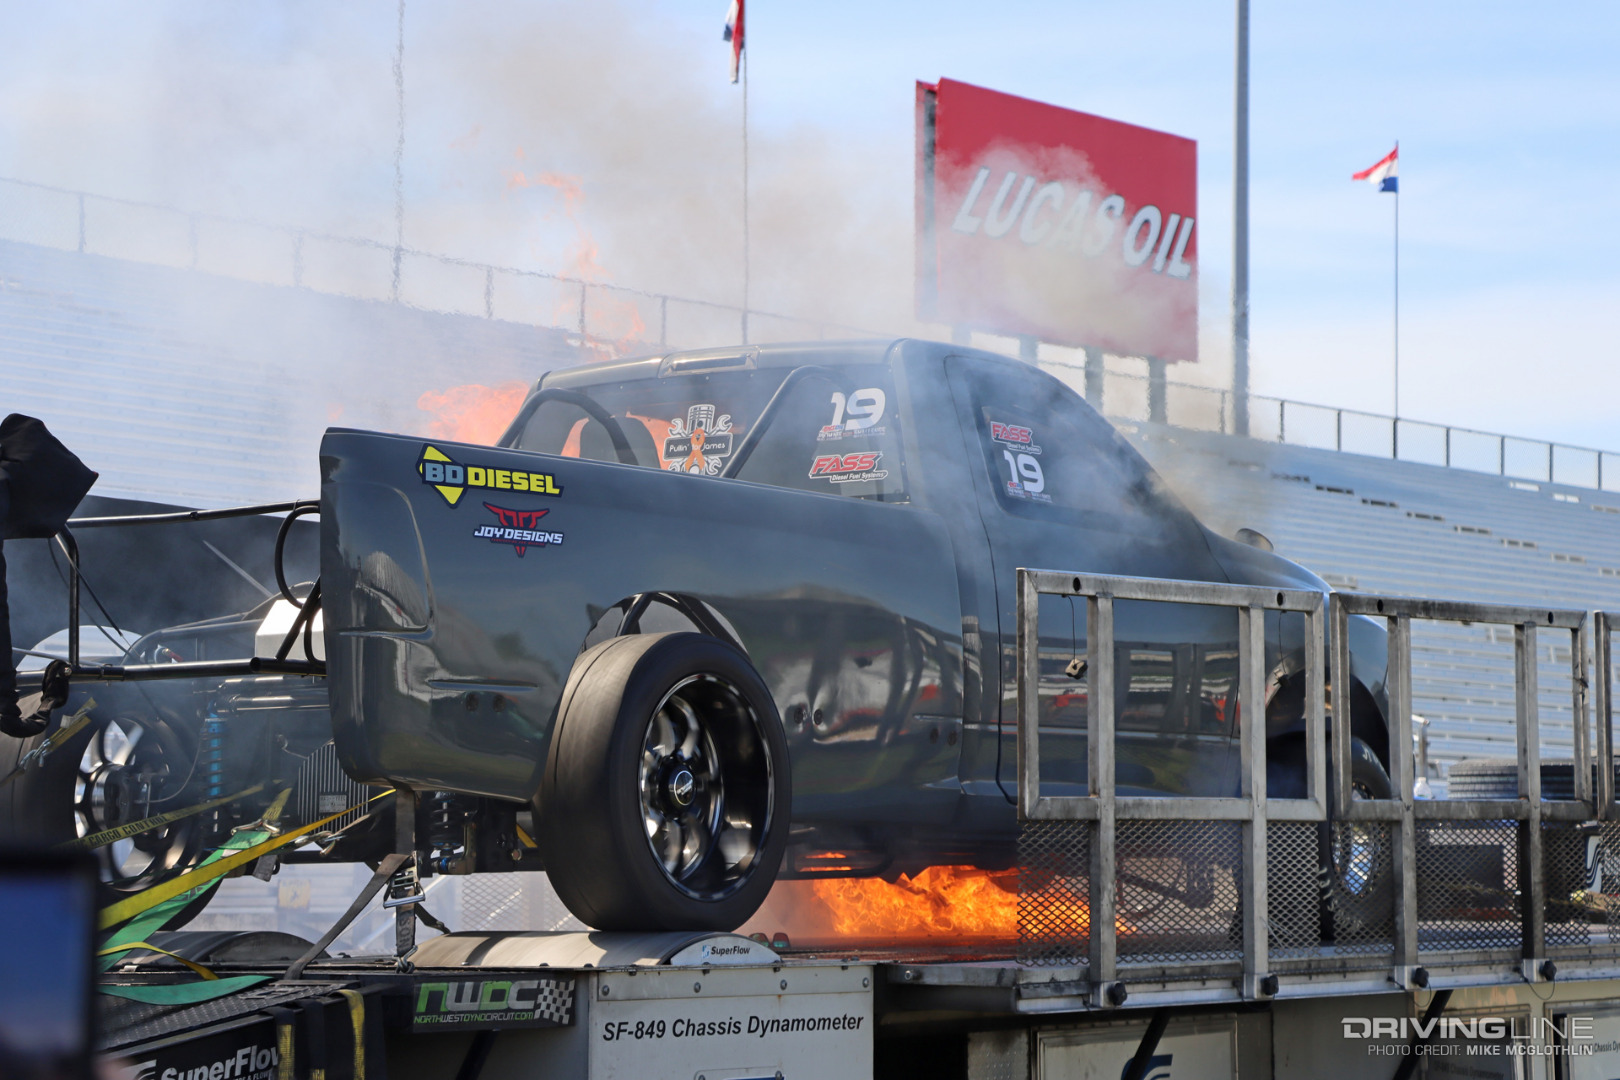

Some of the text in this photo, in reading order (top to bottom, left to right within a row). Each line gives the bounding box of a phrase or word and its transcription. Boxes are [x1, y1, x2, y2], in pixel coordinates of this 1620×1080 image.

[951, 166, 1195, 280] LUCAS OIL
[831, 387, 886, 431] 19
[669, 443, 690, 452] Pullin'
[992, 423, 1031, 444] FASS
[425, 462, 560, 495] BD DIESEL
[811, 453, 878, 475] FASS
[1003, 449, 1045, 493] 19
[89, 829, 122, 845] CARGO
[122, 814, 169, 837] CONTROL
[710, 945, 751, 956] SuperFlow
[414, 1011, 534, 1024] NORTHWESTDYNOCIRCUIT.COM
[602, 1012, 865, 1042] SF-849 Chassis Dynamometer
